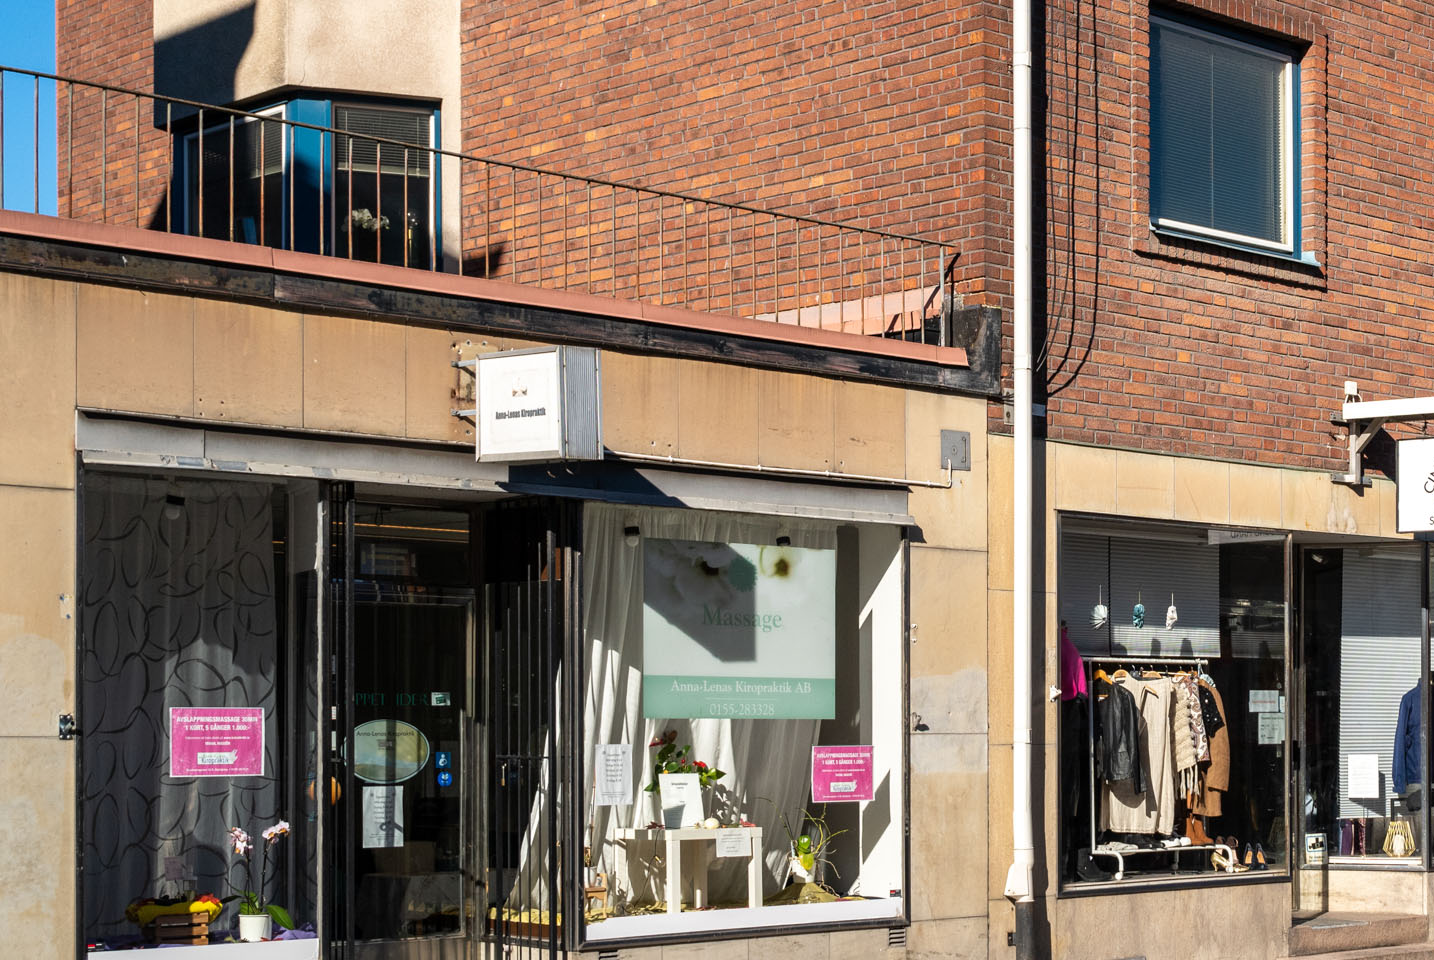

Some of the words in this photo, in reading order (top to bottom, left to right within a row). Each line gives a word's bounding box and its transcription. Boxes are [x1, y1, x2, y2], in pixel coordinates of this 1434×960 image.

[495, 410, 521, 420] Anna-Lenas
[521, 407, 546, 417] Kiropraktik
[702, 604, 782, 633] Massage
[671, 680, 732, 692] Anna-Lenas
[735, 680, 792, 695] Kiropraktik
[794, 682, 812, 693] AB
[709, 703, 775, 716] 0155-283328
